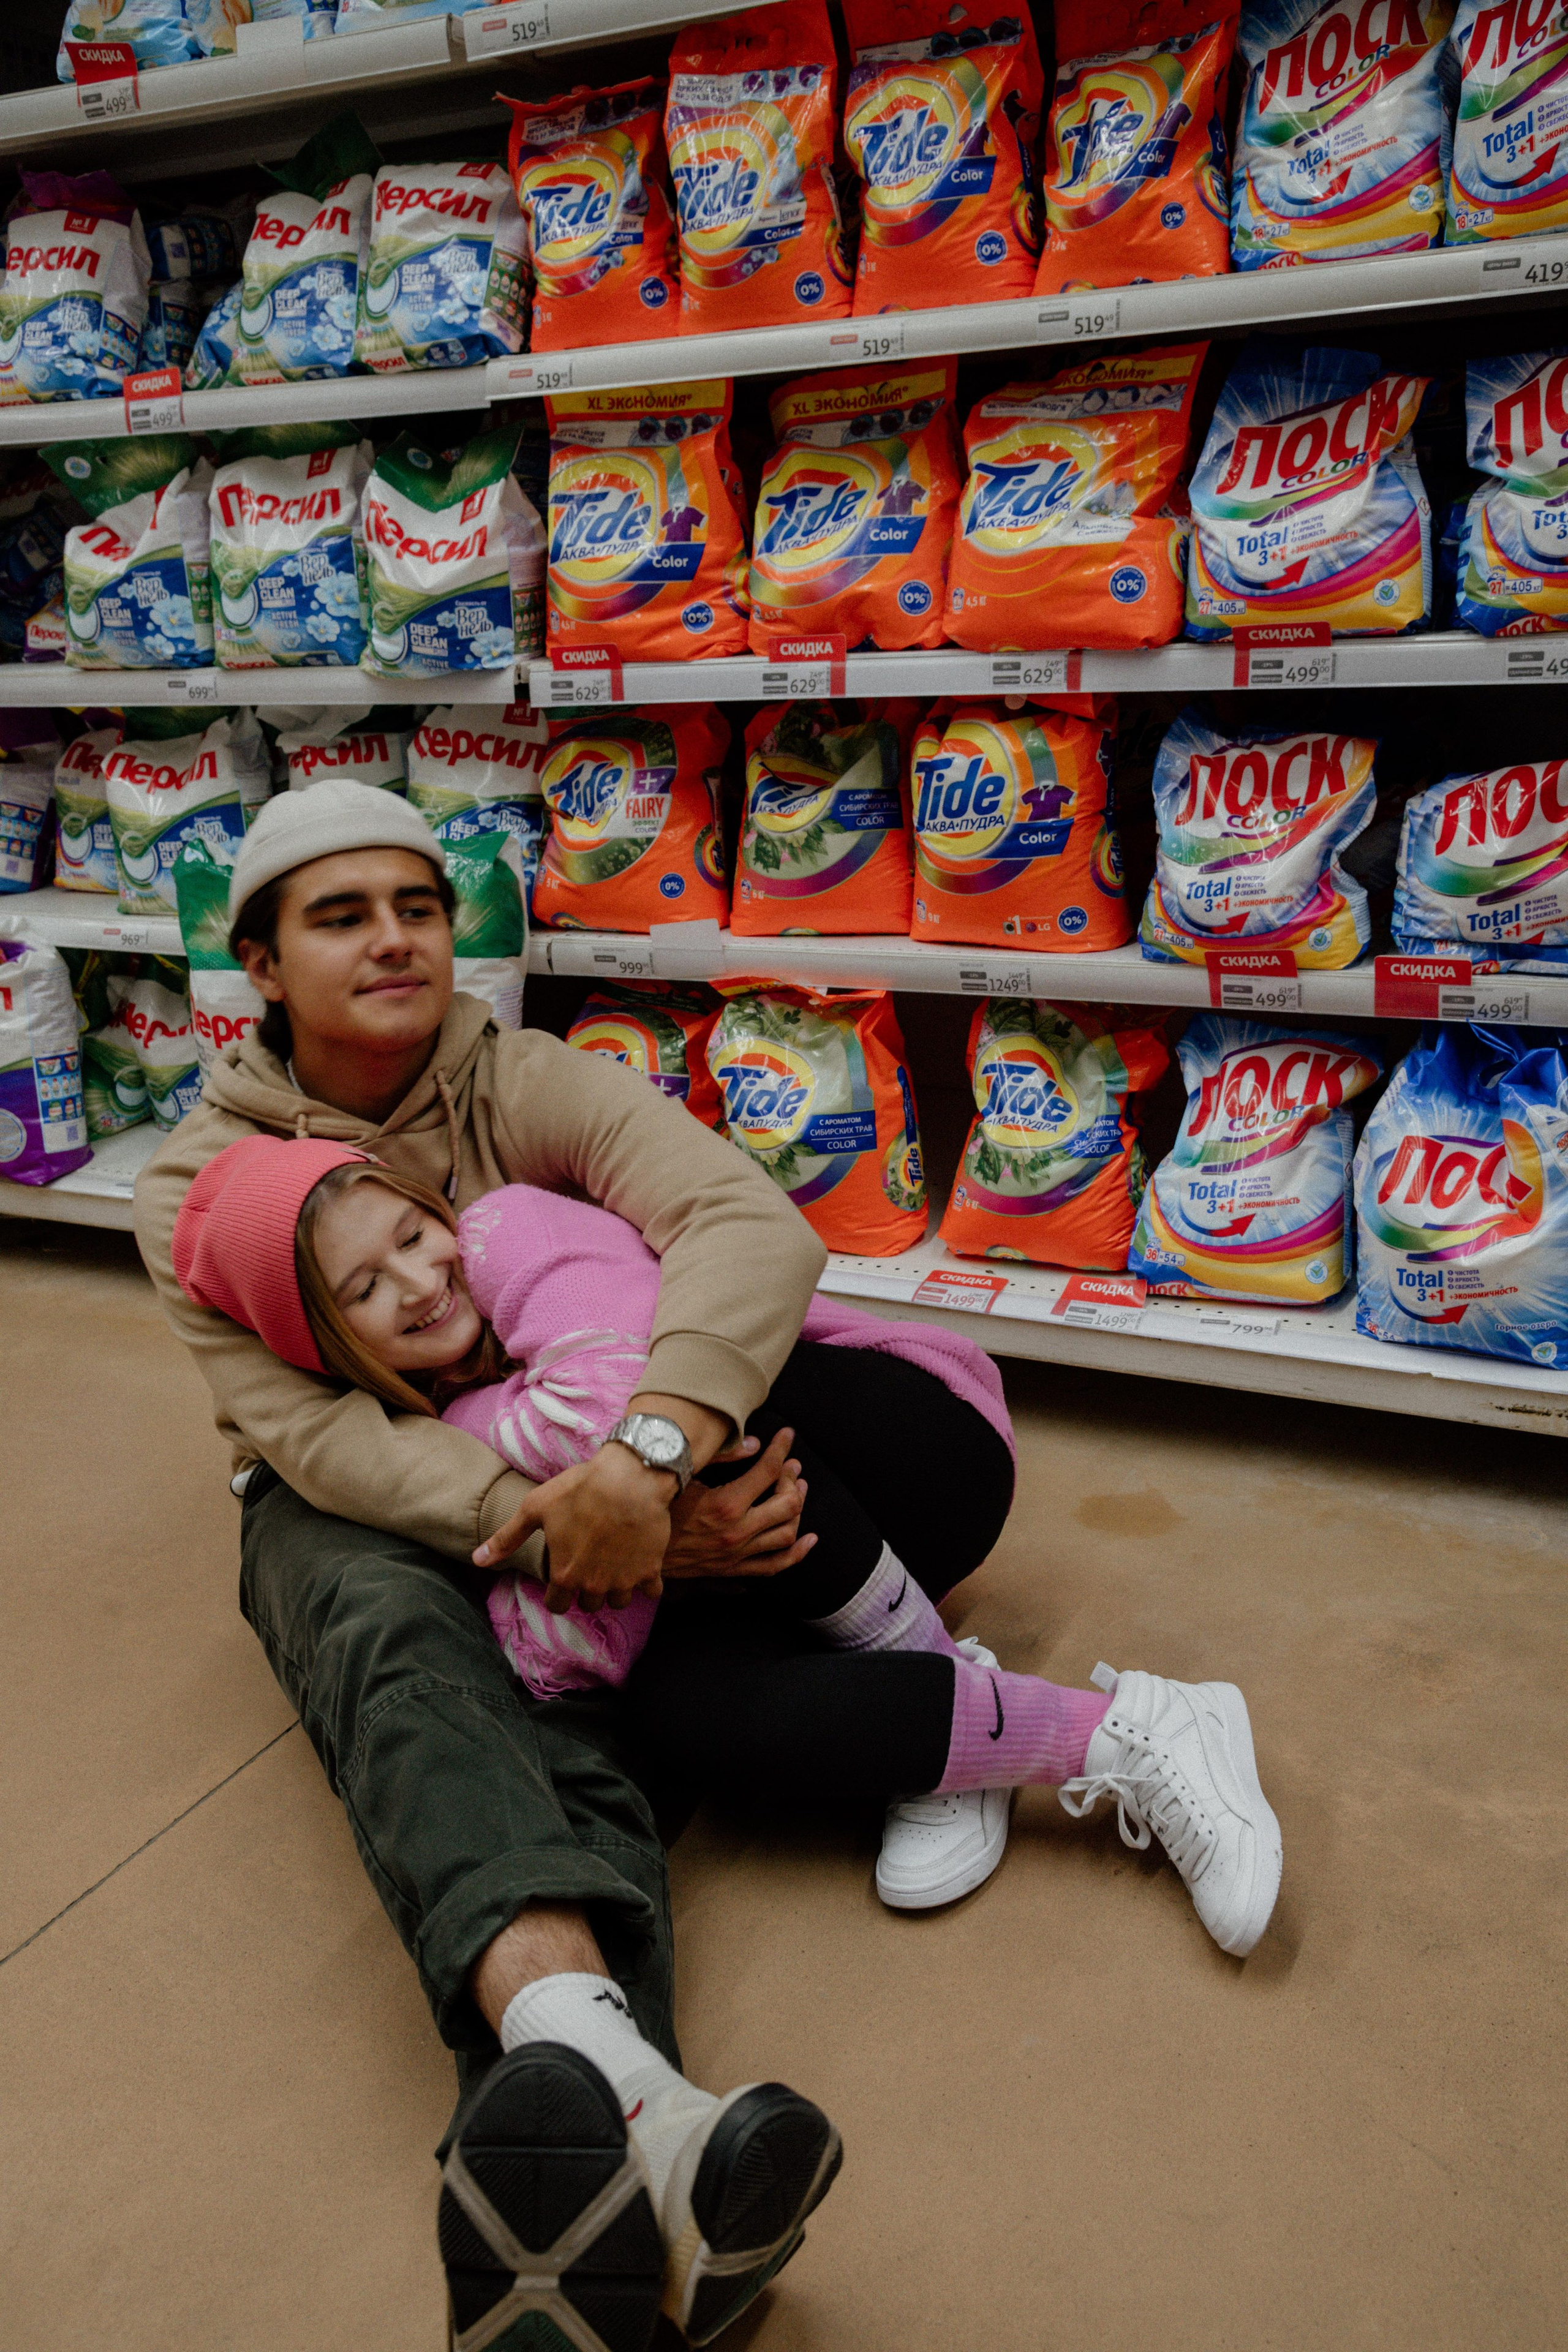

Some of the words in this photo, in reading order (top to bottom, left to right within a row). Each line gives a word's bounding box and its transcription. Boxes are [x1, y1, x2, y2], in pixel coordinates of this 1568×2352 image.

[512, 21, 537, 41] 519
[78, 48, 126, 64] СКИДКА
[1258, 0, 1429, 115] ЛОСК
[1316, 44, 1390, 99] COLOR
[105, 98, 127, 113] 499
[1483, 110, 1534, 158] Total
[853, 106, 950, 184] Tide
[1506, 135, 1536, 164] 3+1
[1138, 151, 1165, 164] Color
[1287, 140, 1330, 176] Total
[951, 169, 983, 183] Color
[674, 156, 760, 235] Tide
[525, 179, 612, 252] Tide
[1165, 211, 1182, 221] 0%
[1456, 214, 1466, 230] 18
[609, 233, 633, 244] Color
[764, 227, 793, 241] Color
[981, 243, 1002, 256] 0%
[6, 246, 100, 277] ерсил
[401, 264, 429, 274] DEEP
[401, 274, 435, 284] CLEAN
[1525, 262, 1563, 283] 419
[645, 287, 663, 298] 0%
[801, 282, 820, 295] 0%
[1074, 315, 1105, 335] 519
[863, 338, 890, 356] 519
[132, 375, 172, 392] СКИДКА
[537, 372, 560, 389] 519
[588, 398, 602, 410] XL
[793, 402, 810, 415] XL
[153, 413, 172, 428] 499
[1216, 372, 1417, 495] ЛОСК
[1281, 451, 1368, 489] COLOR
[963, 461, 1087, 538] Tide
[755, 478, 867, 557] Tide
[549, 490, 652, 567] Tide
[870, 527, 908, 541] Color
[1237, 526, 1289, 557] Total
[652, 555, 689, 570] Color
[258, 576, 285, 589] DEEP
[1117, 580, 1139, 592] 0%
[1490, 581, 1502, 595] 27
[260, 587, 295, 601] CLEAN
[905, 592, 925, 605] 0%
[99, 598, 121, 608] DEEP
[1199, 601, 1210, 614] 27
[100, 608, 131, 620] CLEAN
[456, 608, 486, 625] Вер
[688, 612, 708, 624] 0%
[410, 623, 439, 636] DEEP
[1248, 626, 1315, 642] СКИДКА
[411, 635, 448, 649] CLEAN
[780, 641, 833, 658] СКИДКА
[562, 649, 610, 665] СКИДКА
[1023, 668, 1053, 684] 629
[1286, 666, 1319, 683] 499
[189, 687, 208, 698] 699
[576, 687, 600, 700] 629
[791, 679, 816, 693] 629
[1174, 736, 1353, 826] ЛОСК
[915, 754, 1006, 832] Tide
[625, 797, 665, 820] FAIRY
[633, 818, 660, 827] ЭФФЕКТ
[856, 816, 884, 826] COLOR
[1226, 804, 1307, 830] COLOR
[450, 821, 480, 835] DEEP
[1019, 831, 1058, 845] Color
[1110, 835, 1126, 881] Tide
[665, 881, 680, 891] 0%
[1186, 876, 1232, 900] Total
[1204, 897, 1231, 913] 3+1
[1064, 915, 1082, 926] 0%
[1466, 903, 1521, 932] Total
[1038, 923, 1051, 932] LG
[1492, 922, 1521, 941] 3+1
[121, 934, 140, 945] 969
[619, 961, 643, 974] 999
[1219, 955, 1281, 969] СКИДКА
[1390, 963, 1457, 980] СКИДКА
[990, 978, 1019, 992] 1249
[1256, 993, 1287, 1008] 499
[1478, 1004, 1512, 1019] 499
[718, 1065, 811, 1125] Tide
[980, 1061, 1073, 1123] Tide
[1188, 1050, 1362, 1137] ЛОСК
[825, 1117, 862, 1126] АРОМАТОМ
[1227, 1104, 1305, 1133] COLOR
[810, 1126, 854, 1137] СИБИРСКИХ
[855, 1125, 873, 1134] ТРАВ
[827, 1140, 857, 1150] COLOR
[910, 1147, 923, 1188] Tide
[1188, 1180, 1237, 1200] Total
[1207, 1199, 1235, 1214] 3+1
[1146, 1248, 1157, 1261] 36
[939, 1273, 992, 1287] СКИДКА
[1396, 1267, 1444, 1287] Total
[1080, 1281, 1134, 1297] СКИДКА
[1417, 1288, 1445, 1303] 3+1
[1449, 1286, 1518, 1301] +ЭКОНОМИЧНОСТЬ
[945, 1292, 976, 1307] 1499
[1096, 1314, 1128, 1328] 1499
[1495, 1322, 1528, 1332] Горное
[1531, 1319, 1558, 1330] озеро
[1232, 1324, 1264, 1334] 799
